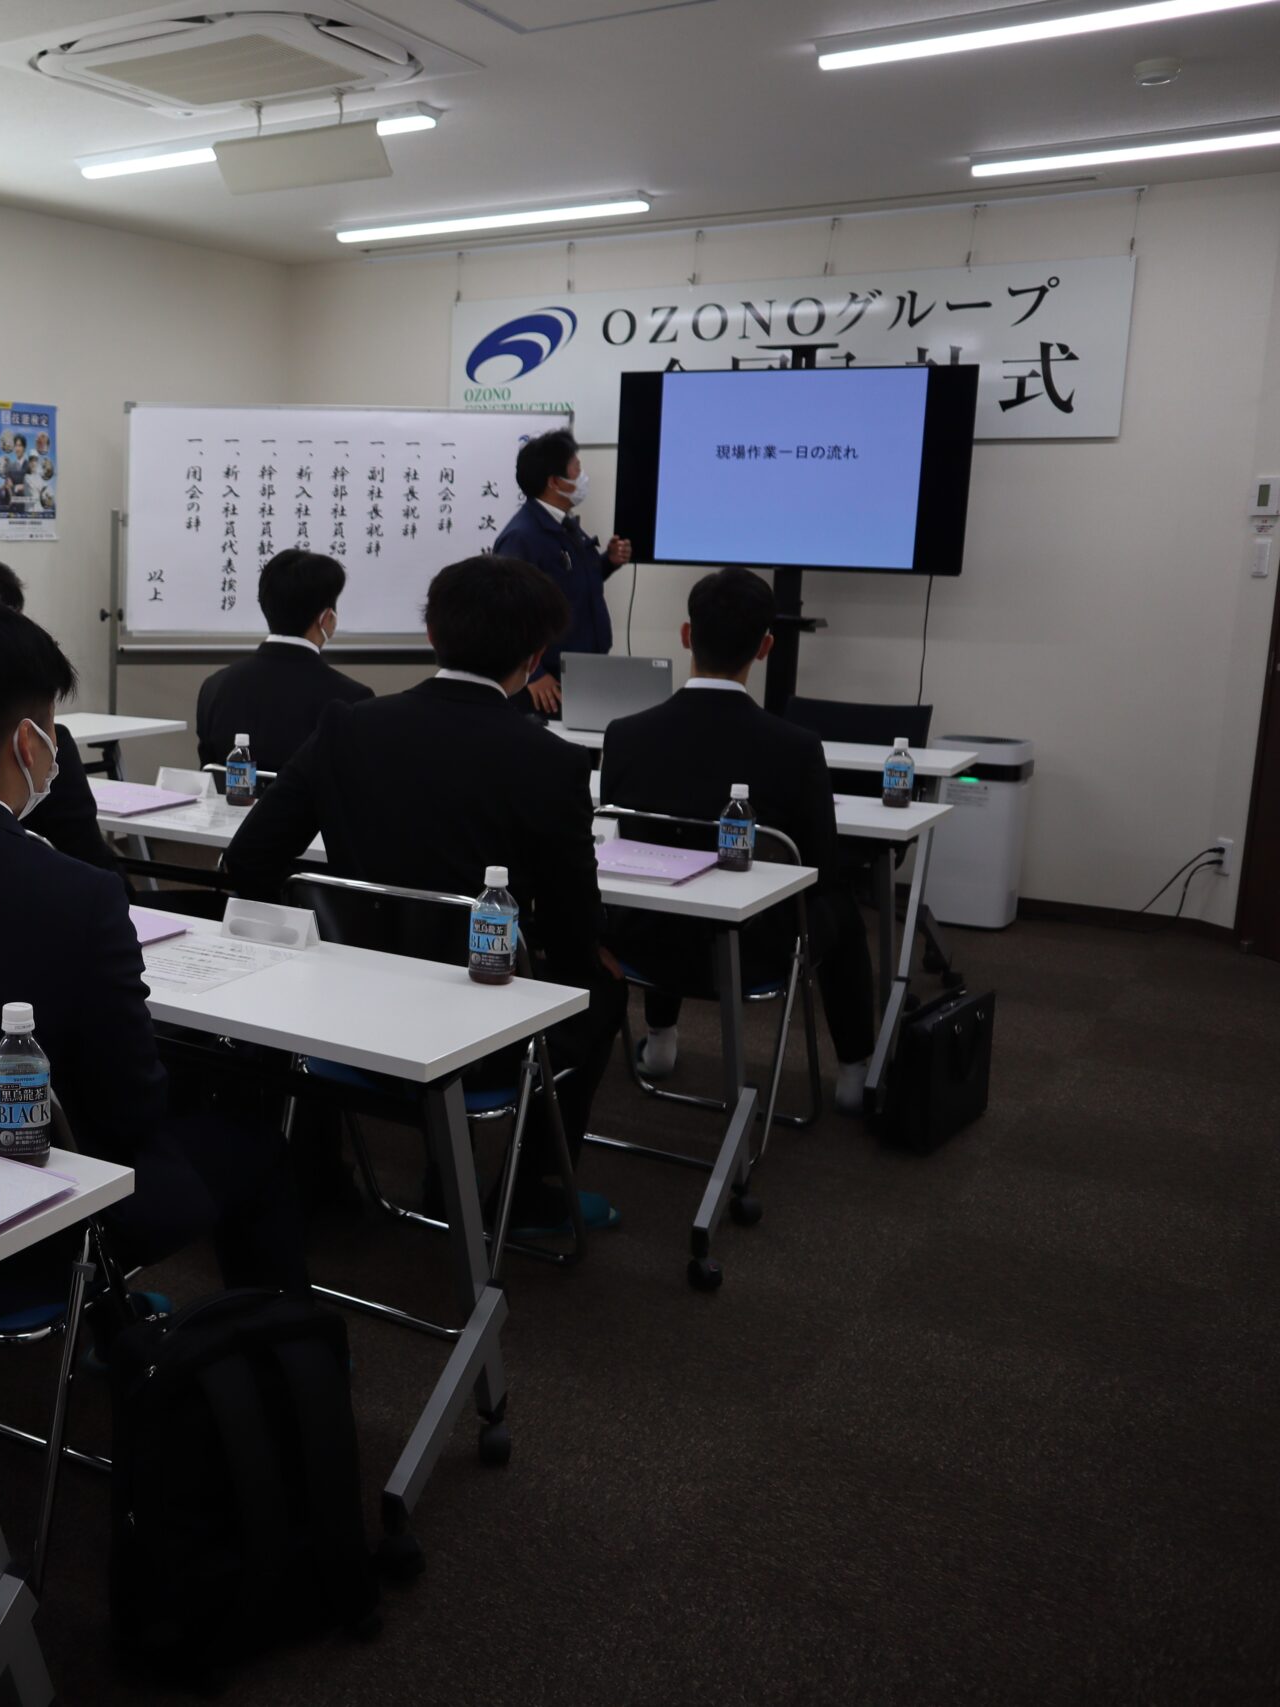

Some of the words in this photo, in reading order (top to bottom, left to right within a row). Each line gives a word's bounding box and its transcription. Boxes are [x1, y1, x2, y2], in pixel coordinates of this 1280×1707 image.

[464, 387, 511, 402] OZONO
[716, 445, 859, 461] 現場作業一日の流れ
[328, 439, 350, 569] 一、幹部社員紹
[147, 569, 165, 602] 以上
[471, 935, 508, 951] BLACK
